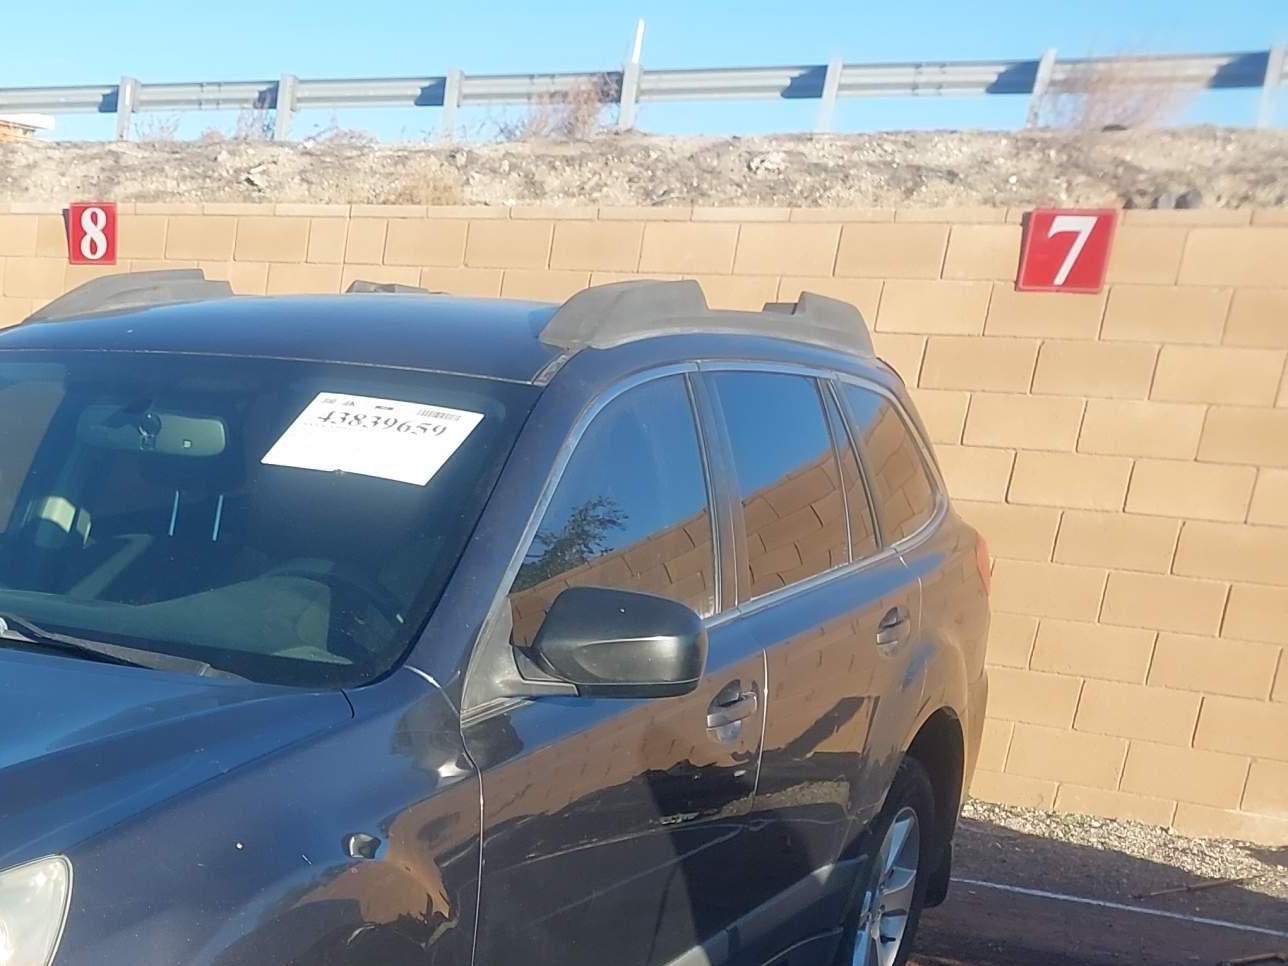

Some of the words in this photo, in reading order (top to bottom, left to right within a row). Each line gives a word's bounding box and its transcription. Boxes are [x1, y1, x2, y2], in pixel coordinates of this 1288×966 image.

[80, 207, 107, 259] 8
[1047, 215, 1099, 285] 7
[316, 410, 447, 436] 43839659
